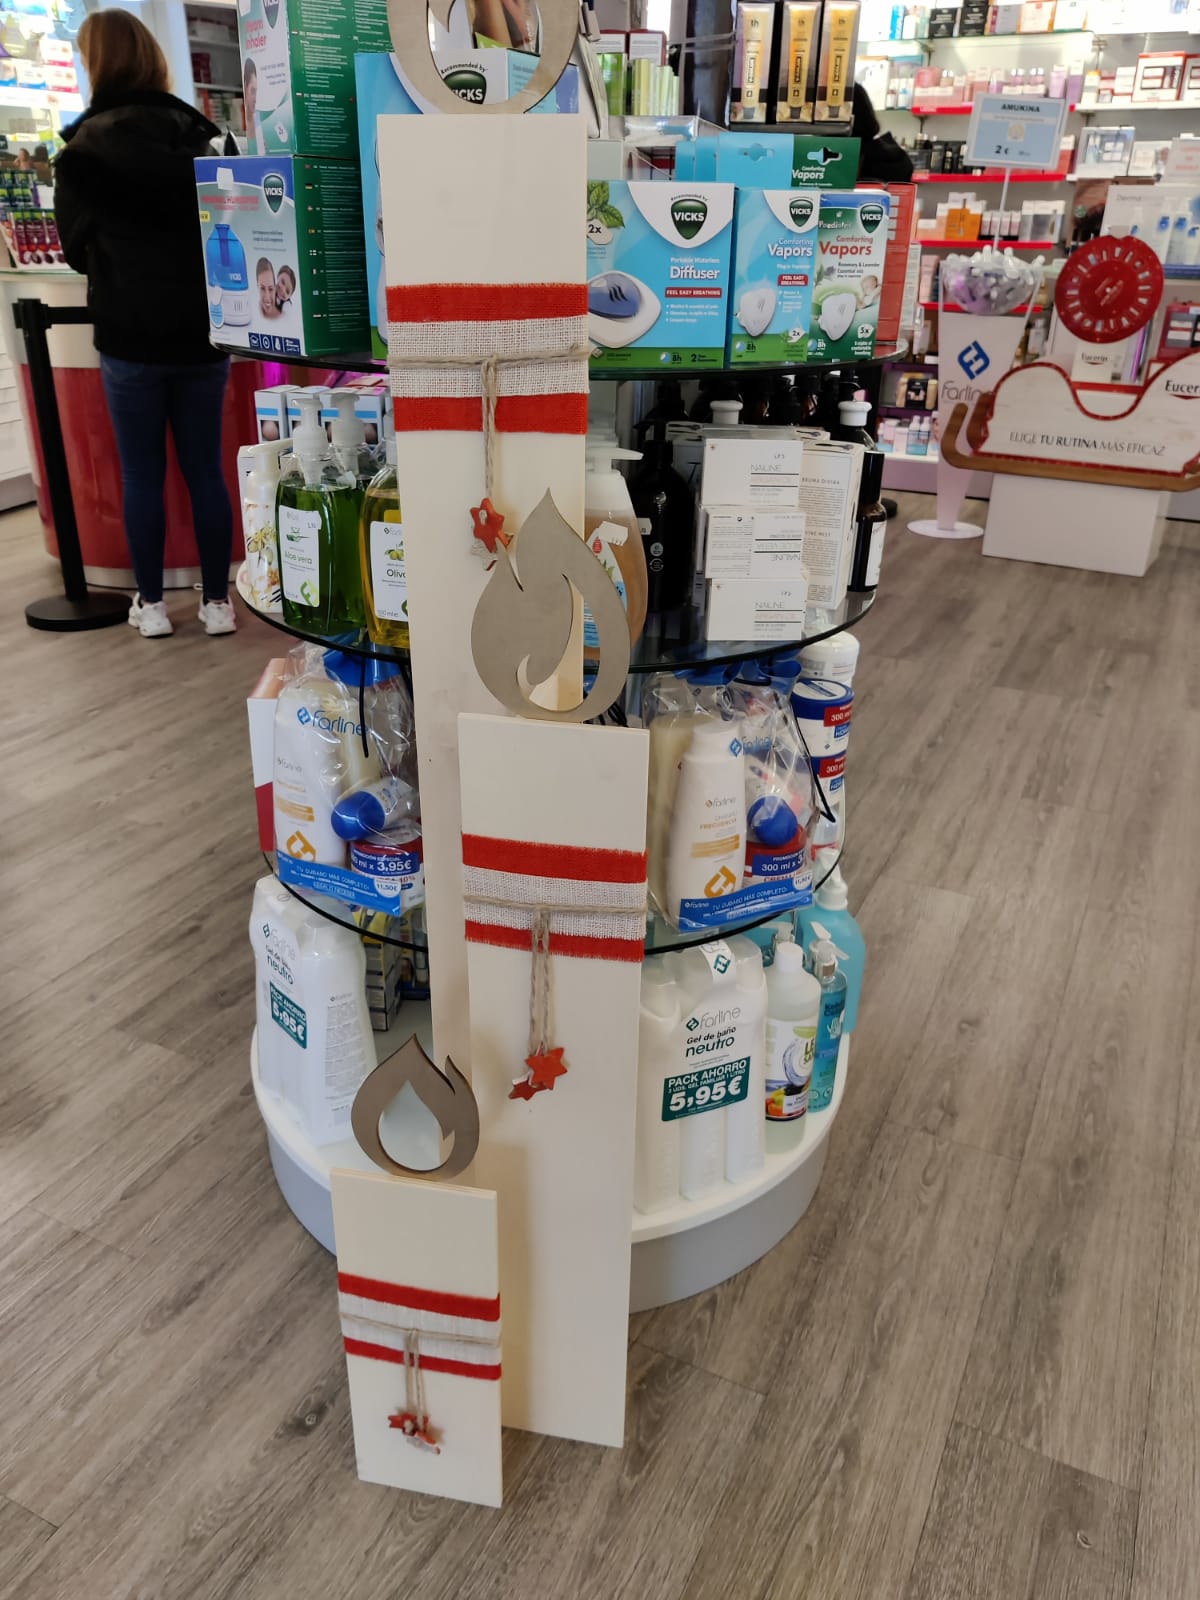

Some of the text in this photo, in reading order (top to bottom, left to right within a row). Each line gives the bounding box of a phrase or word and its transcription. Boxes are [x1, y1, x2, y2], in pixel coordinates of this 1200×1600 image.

[441, 61, 478, 75] Recommended
[1001, 103, 1040, 113] AMUKINA
[792, 169, 824, 181] Vapors
[265, 187, 283, 196] VICKS
[673, 212, 705, 222] VICKS
[862, 213, 882, 221] VICKS
[588, 224, 602, 234] 2x
[780, 238, 813, 246] Comforting
[836, 235, 873, 244] Comforting
[768, 242, 814, 259] Vapors
[819, 241, 872, 259] Vapors
[670, 264, 720, 279] Diffuser
[860, 326, 869, 334] 5x
[1009, 431, 1038, 444] ELIGE
[1040, 434, 1054, 445] TU
[1055, 436, 1097, 449] RUTINA
[377, 860, 411, 871] 3,95€
[761, 863, 778, 872] 300
[780, 861, 791, 870] ml
[267, 955, 294, 985] neutro
[273, 1001, 305, 1041] 5,95€
[686, 1026, 737, 1045] Gel de baño
[686, 1036, 735, 1057] neutro
[668, 1060, 747, 1088] PACK AHORRO
[670, 1075, 742, 1112] 5,95€
